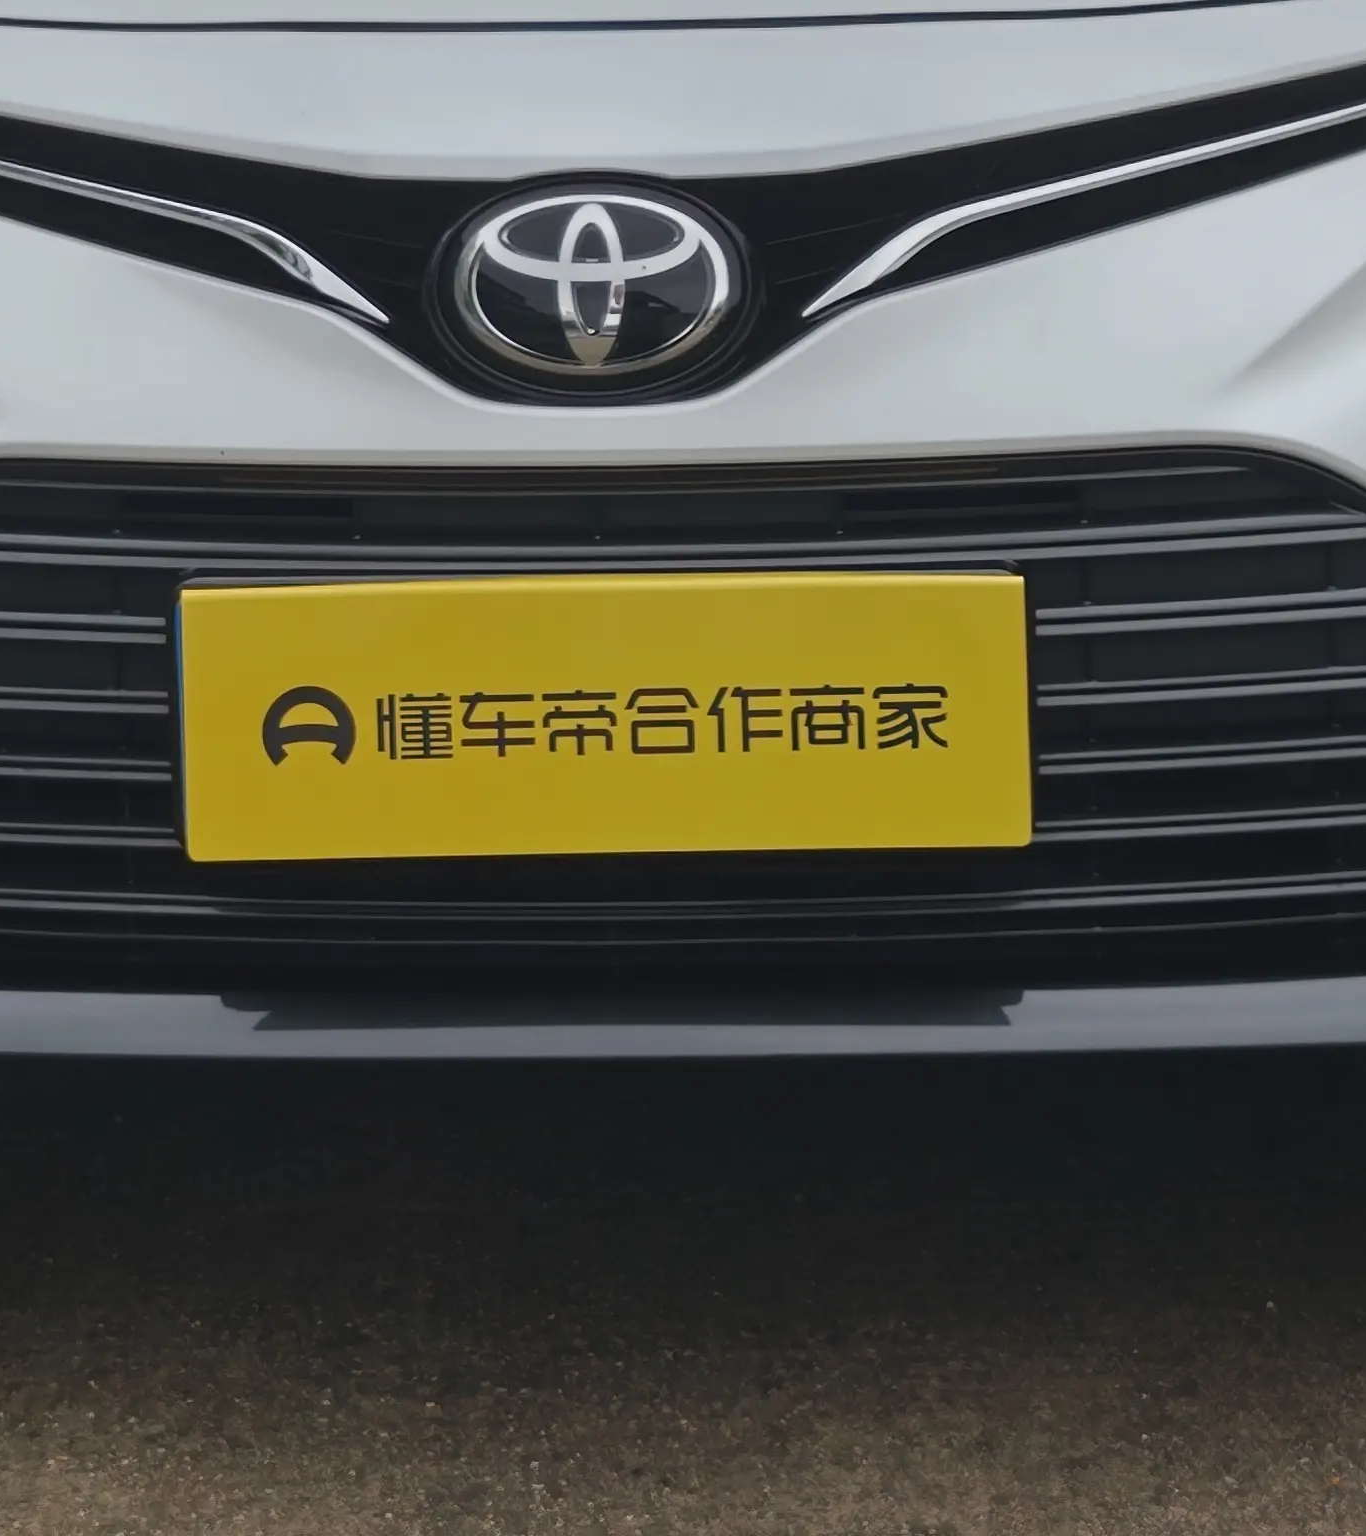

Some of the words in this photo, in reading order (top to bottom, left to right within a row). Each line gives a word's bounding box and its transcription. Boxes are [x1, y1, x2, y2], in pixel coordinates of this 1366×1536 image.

[375, 683, 949, 761] 懂车帝合作商家
